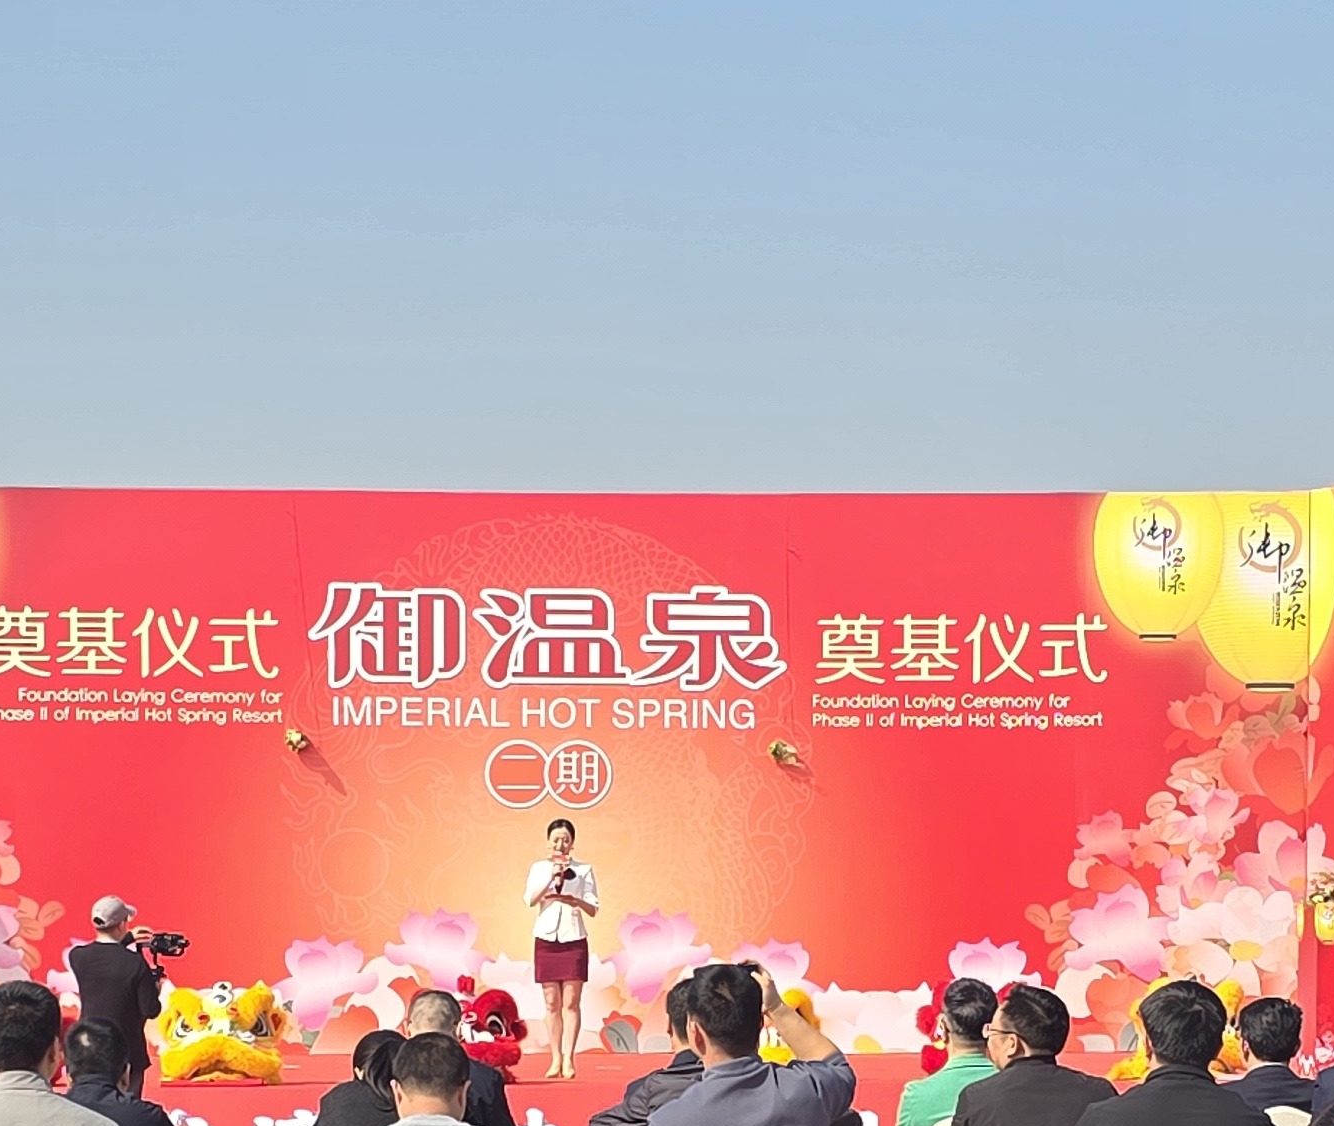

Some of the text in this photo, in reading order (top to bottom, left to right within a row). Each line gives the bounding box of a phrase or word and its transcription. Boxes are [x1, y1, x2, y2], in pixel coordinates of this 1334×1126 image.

[308, 580, 787, 691] 御温泉
[814, 613, 1108, 685] 奠基仪式
[17, 687, 283, 706] Foundation Laying Ceremony for
[812, 693, 1070, 712] Foundation Laying Ceremony for
[40, 707, 48, 721] II
[54, 707, 70, 722] of
[75, 707, 140, 725] Imperial
[144, 707, 172, 722] Hot
[177, 707, 227, 726] Spring
[232, 708, 283, 724] Resort
[331, 696, 756, 730] IMPERIAL HOT SPRING
[812, 712, 1103, 731] Phase II of Imperial Hot Spring Resort
[497, 750, 599, 794] 二期
